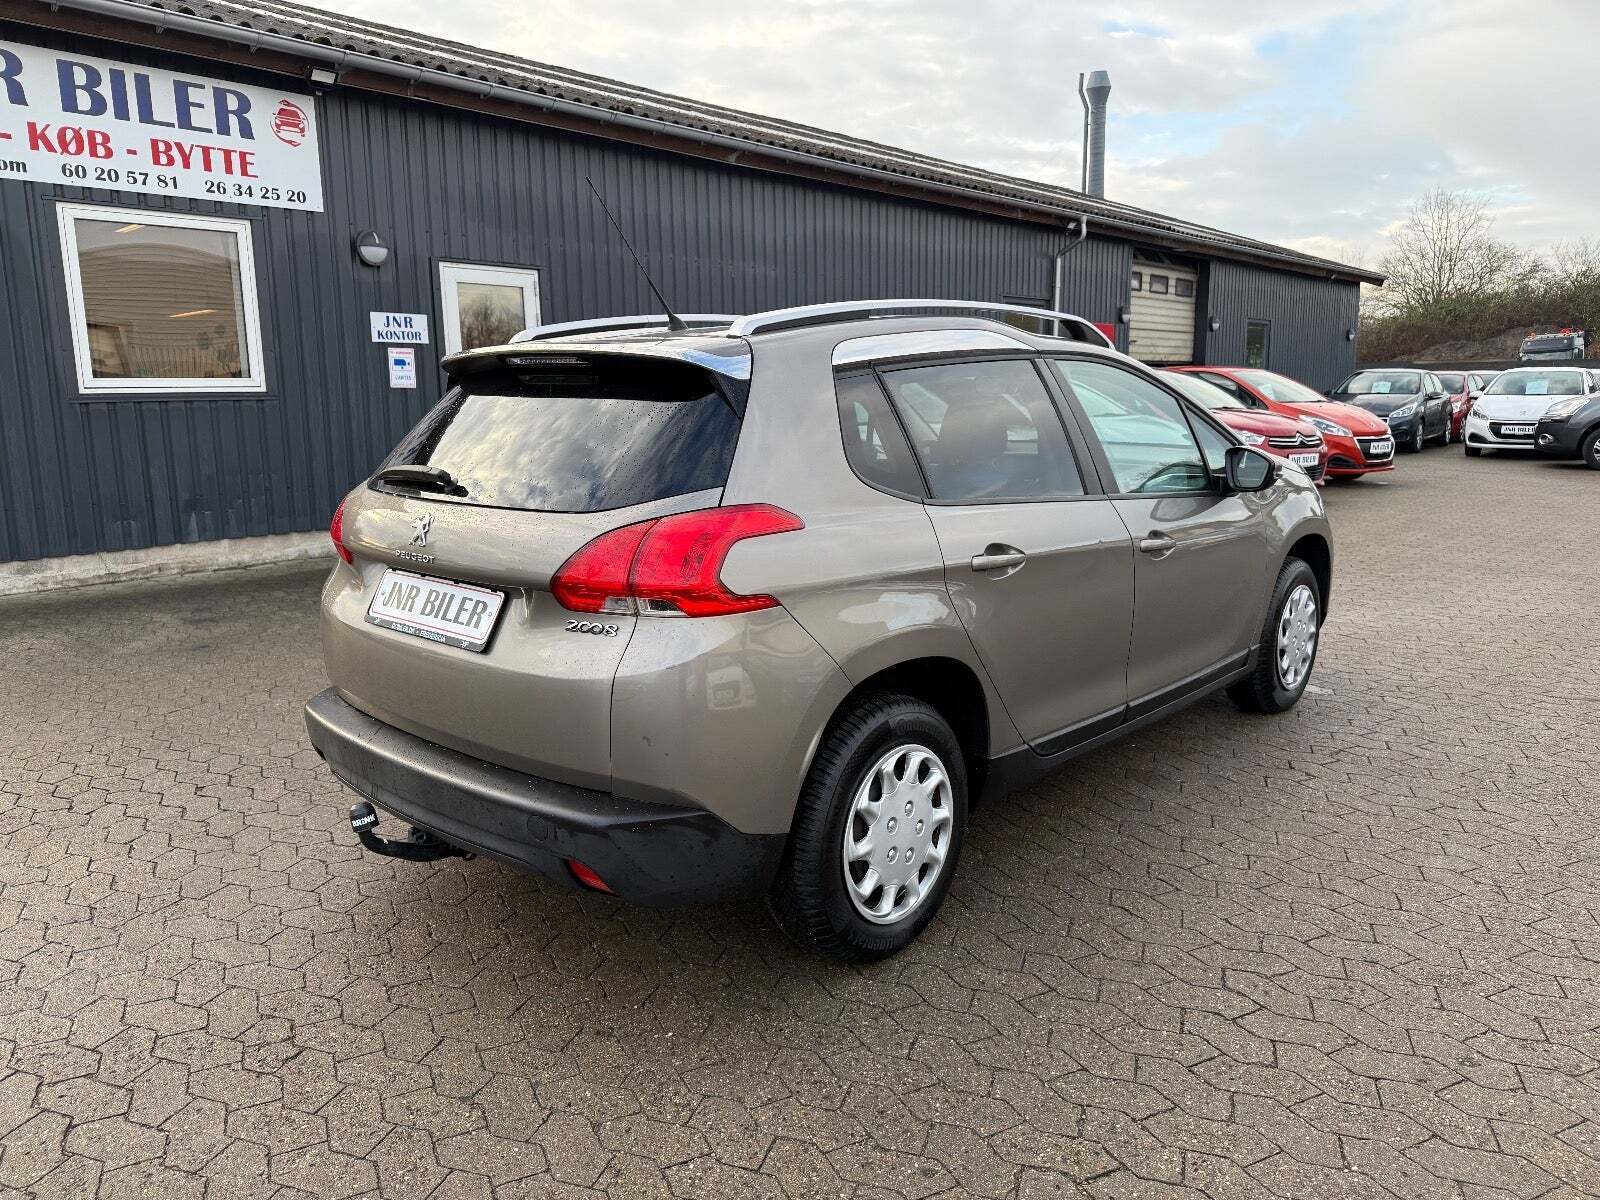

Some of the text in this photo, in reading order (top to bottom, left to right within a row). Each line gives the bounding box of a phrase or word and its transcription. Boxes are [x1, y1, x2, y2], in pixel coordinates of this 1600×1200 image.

[56, 58, 255, 140] BILER
[27, 121, 114, 160] KØB
[150, 137, 259, 179] BYTTE
[61, 162, 88, 179] 60
[95, 166, 120, 183] 20
[126, 170, 149, 186] 57
[156, 174, 178, 189] 81
[204, 179, 227, 195] 26
[233, 183, 254, 198] 34
[260, 186, 281, 201] 25
[286, 189, 307, 204] 20
[377, 329, 422, 341] KONTOR
[384, 315, 414, 329] JNR
[395, 549, 435, 564] PEUGEOT
[382, 581, 488, 630] JNR BILER
[565, 619, 619, 638] 2008
